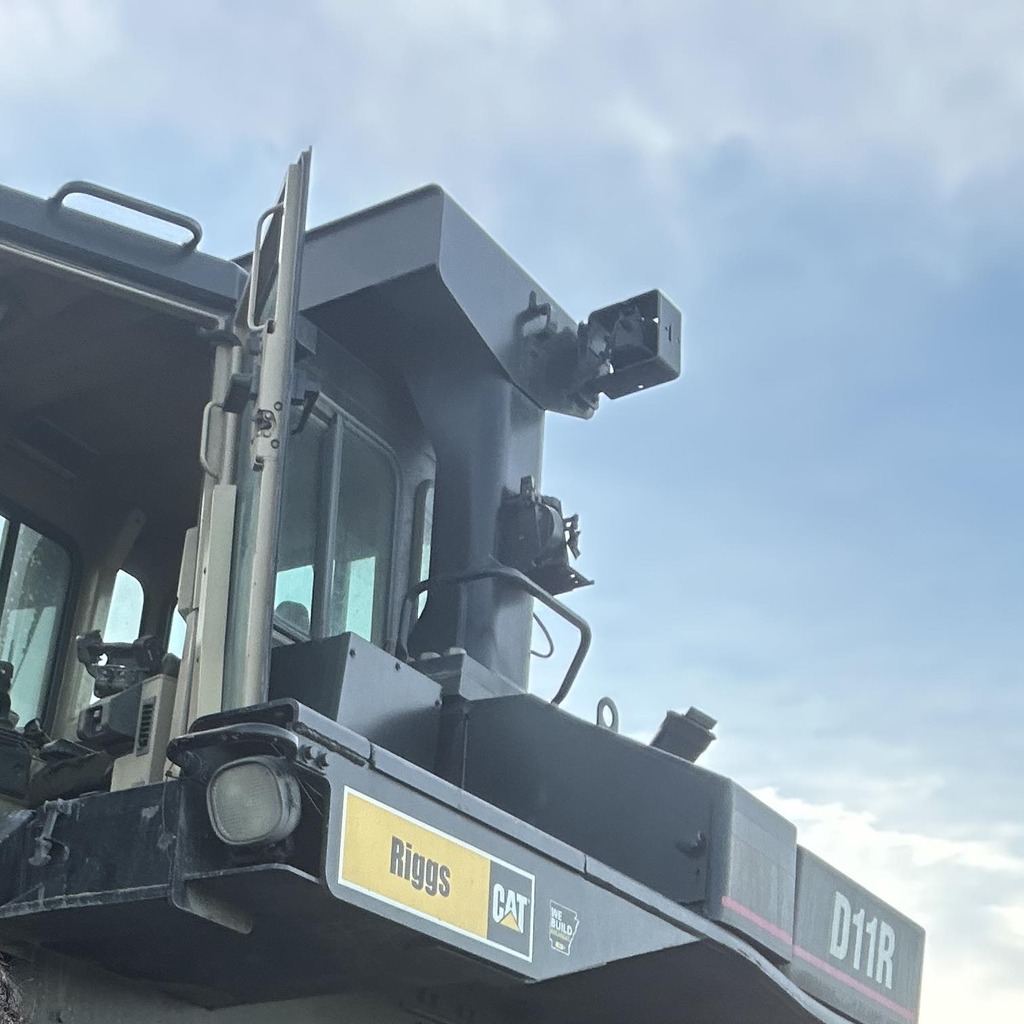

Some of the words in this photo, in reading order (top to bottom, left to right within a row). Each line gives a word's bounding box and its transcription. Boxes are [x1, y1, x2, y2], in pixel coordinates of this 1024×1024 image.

[389, 835, 451, 898] Riggs
[492, 883, 528, 933] CAT
[551, 907, 563, 921] WE
[551, 917, 573, 935] BUILD
[829, 891, 895, 990] D11R
